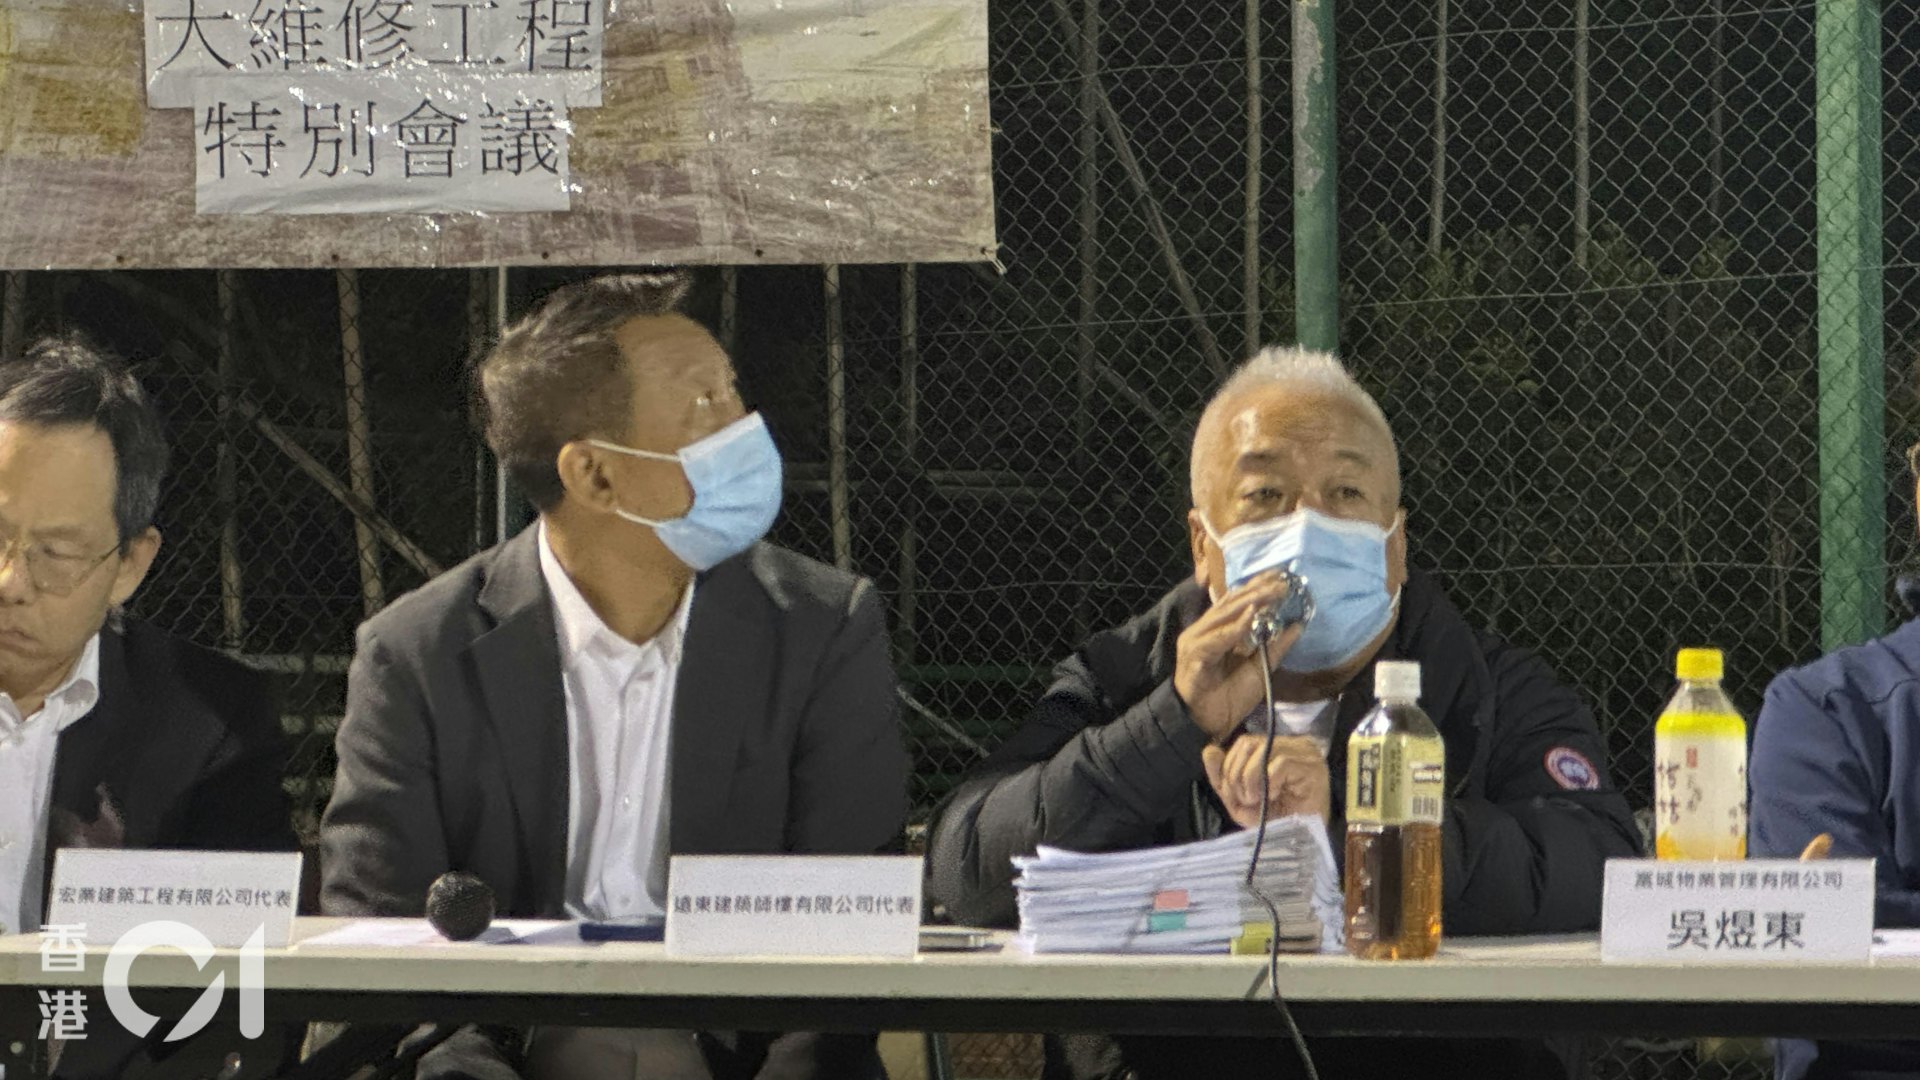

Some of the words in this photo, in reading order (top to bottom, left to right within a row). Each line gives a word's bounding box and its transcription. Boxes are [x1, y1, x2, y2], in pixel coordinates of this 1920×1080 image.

[154, 0, 594, 72] 大維修工程
[204, 99, 559, 179] 特別會議
[59, 886, 292, 907] 宏業建築工程有限公司代表
[1666, 908, 1806, 950] 吳煜東
